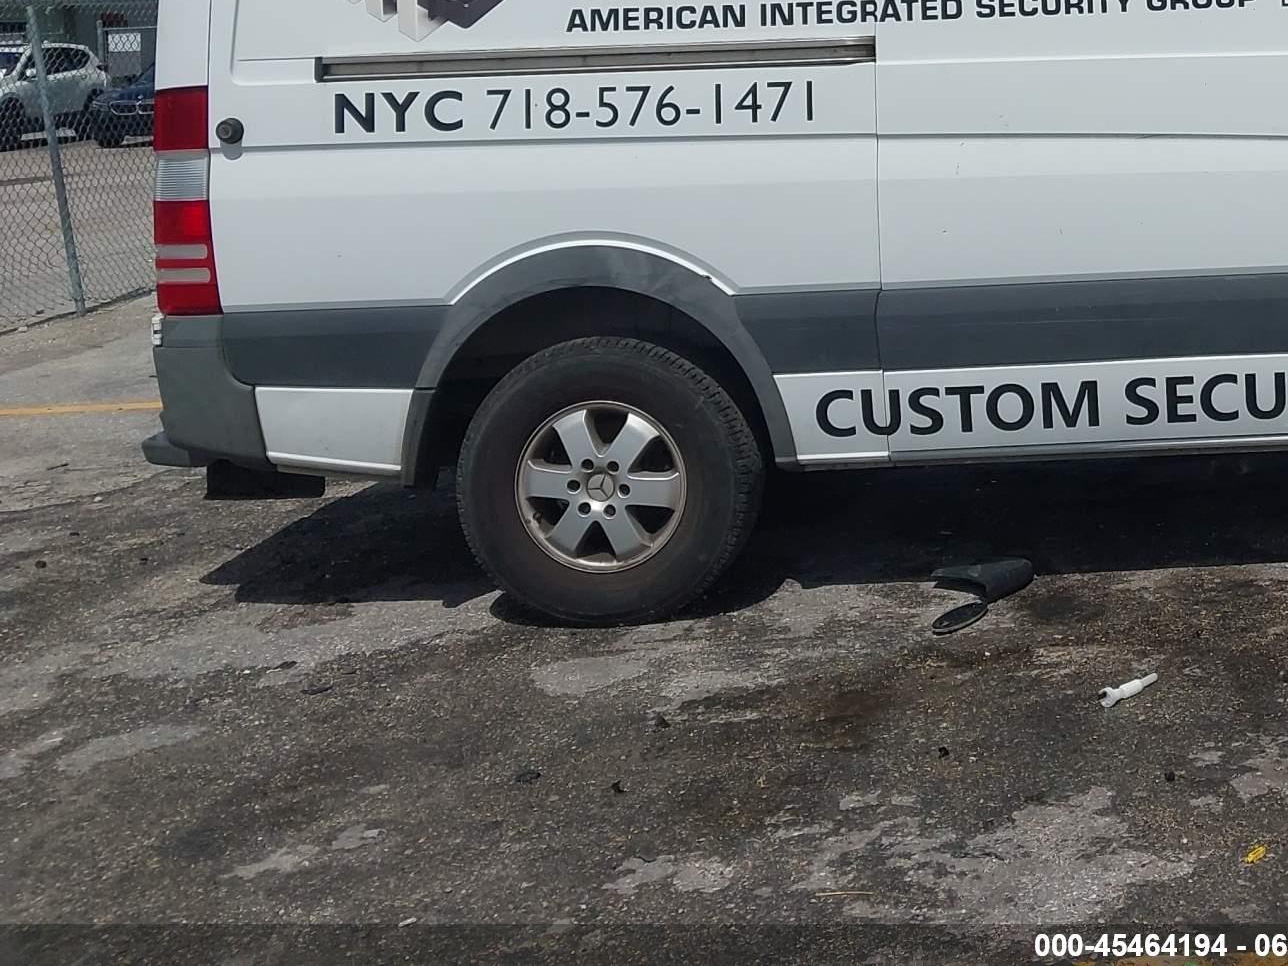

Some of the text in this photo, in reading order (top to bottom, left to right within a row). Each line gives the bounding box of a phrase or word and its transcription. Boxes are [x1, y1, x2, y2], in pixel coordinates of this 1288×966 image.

[566, 3, 746, 32] AMERICAN
[334, 80, 815, 134] NYC 718-576-1471
[815, 380, 1100, 436] CUSTOM
